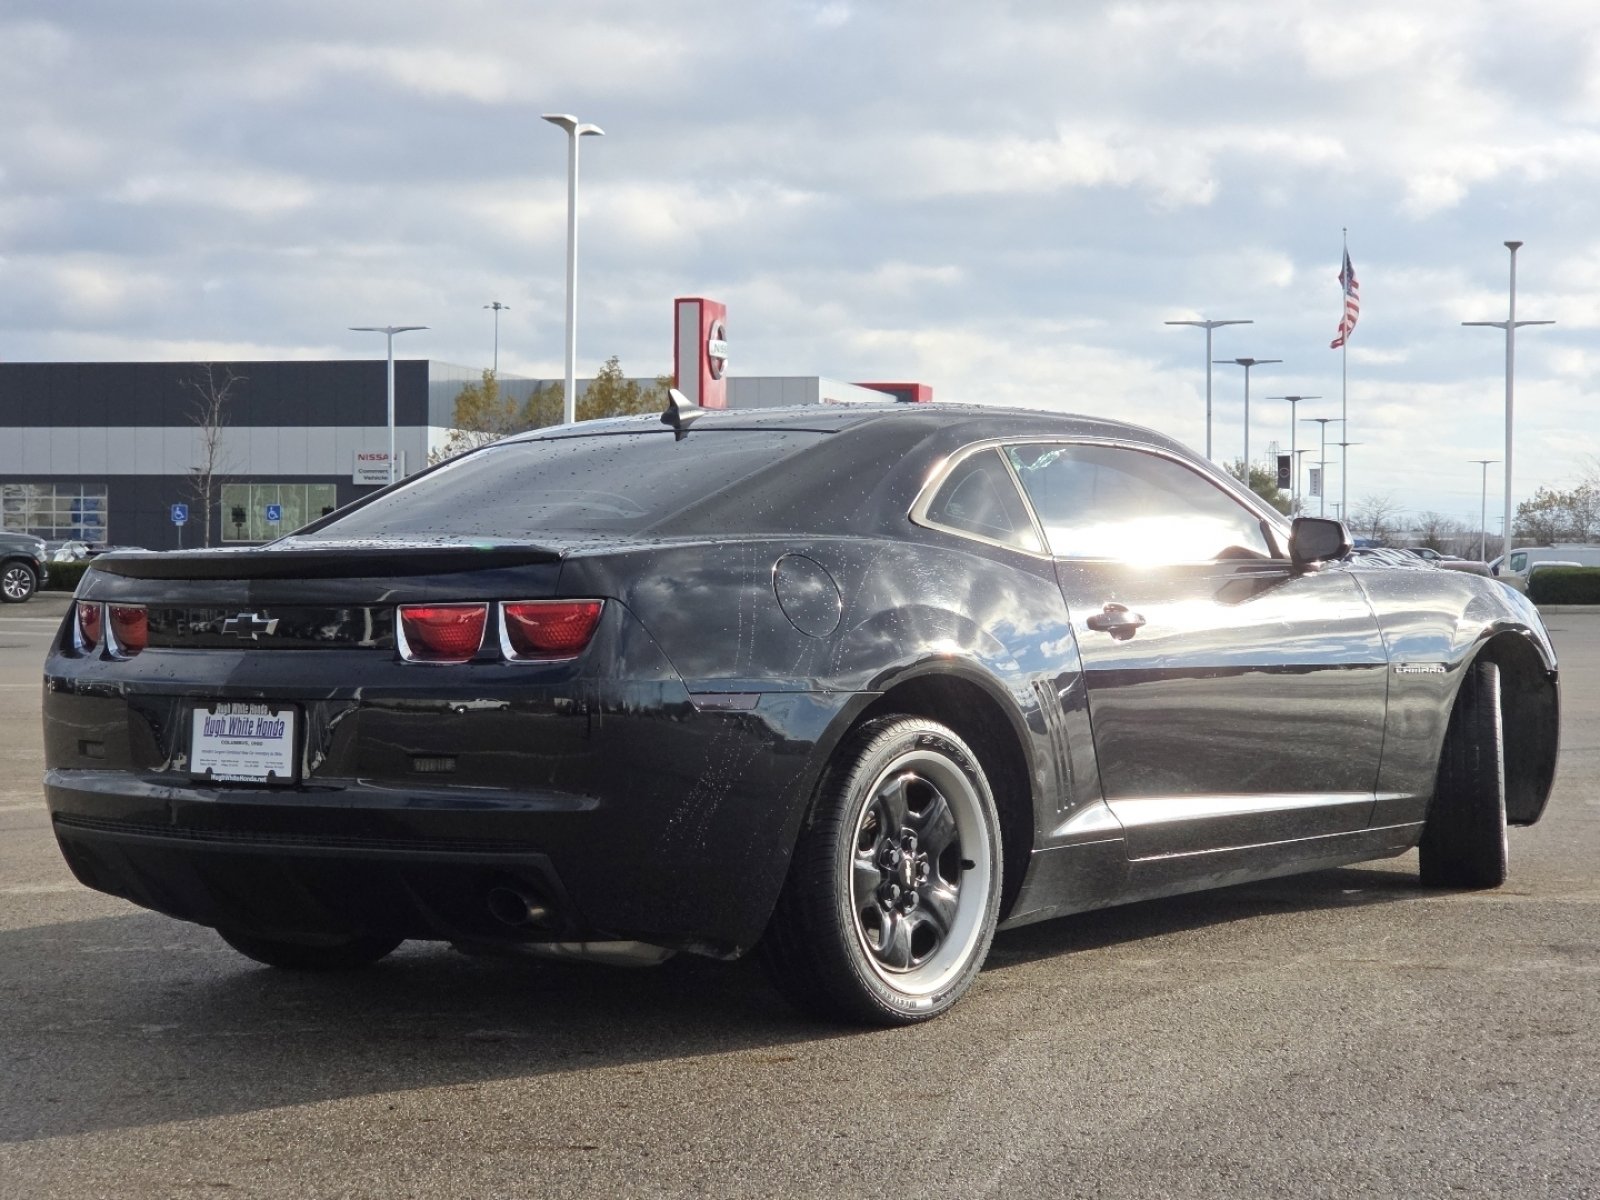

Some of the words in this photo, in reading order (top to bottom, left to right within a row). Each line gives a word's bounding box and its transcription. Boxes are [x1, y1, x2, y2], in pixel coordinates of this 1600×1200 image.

[204, 716, 227, 737] Hugh
[229, 717, 254, 736] White
[256, 718, 285, 737] Honda
